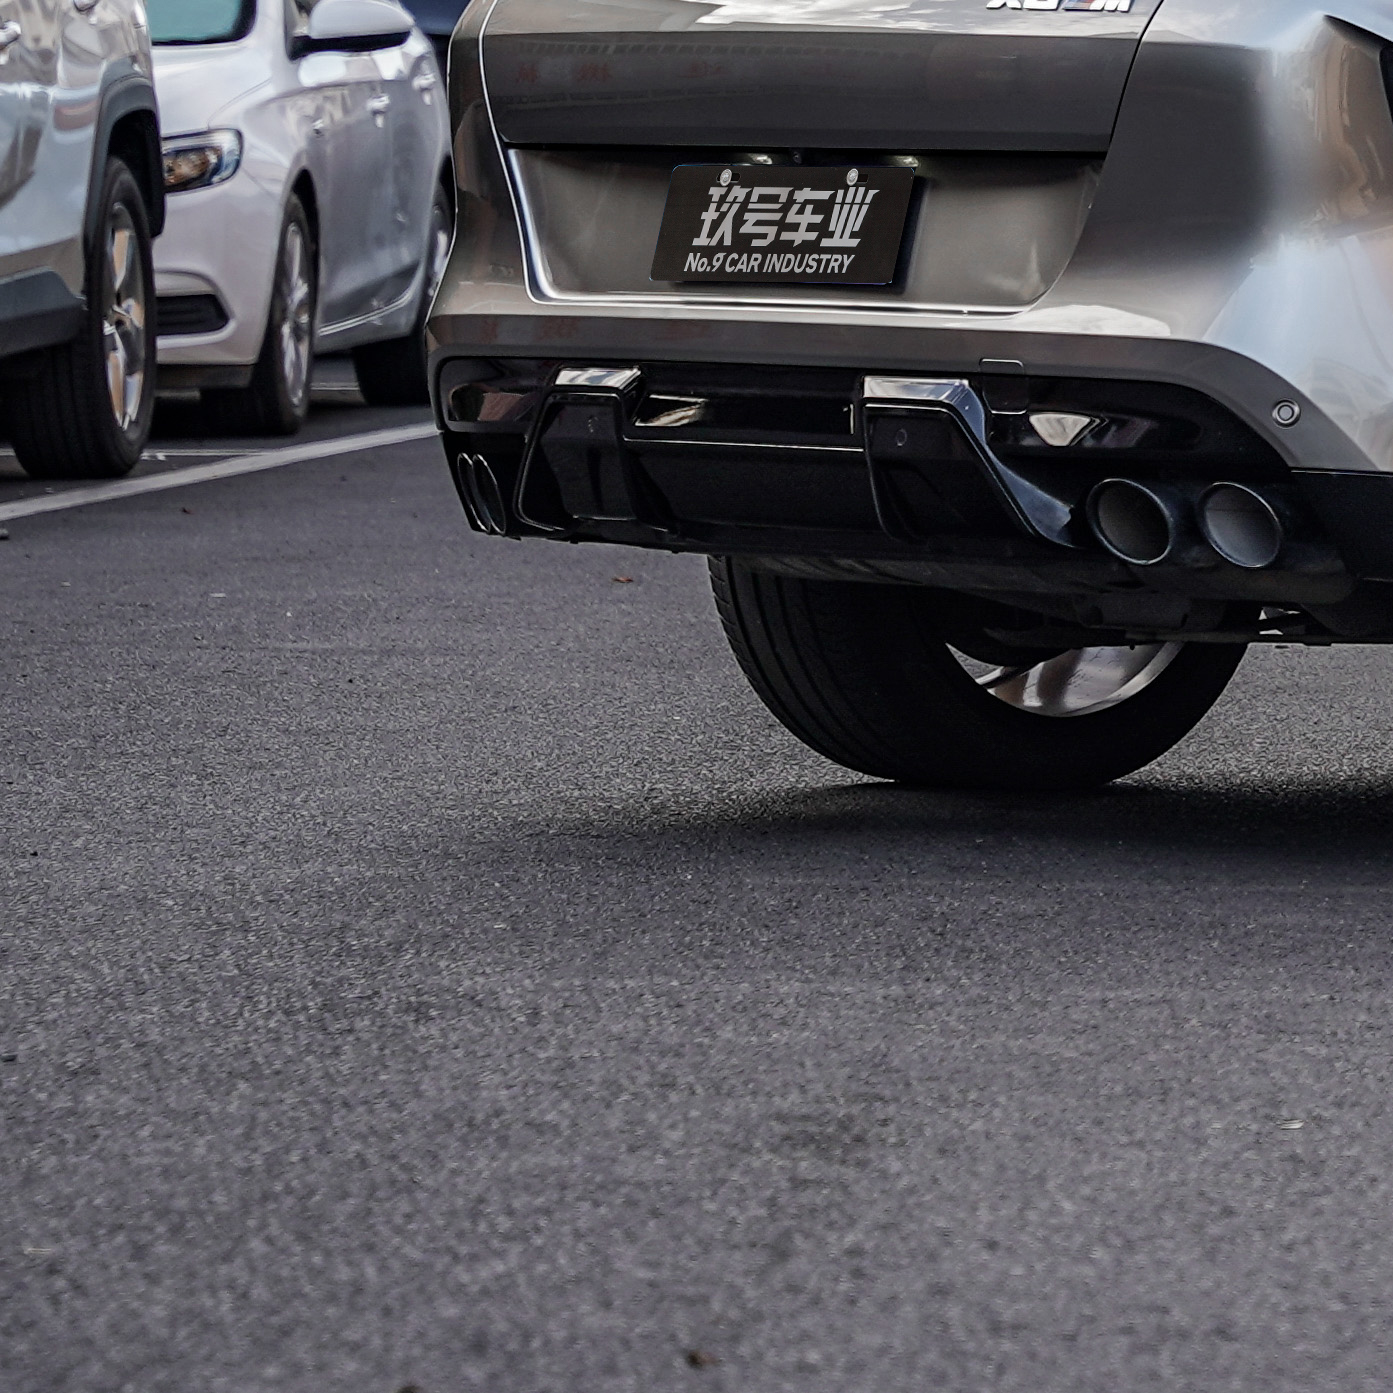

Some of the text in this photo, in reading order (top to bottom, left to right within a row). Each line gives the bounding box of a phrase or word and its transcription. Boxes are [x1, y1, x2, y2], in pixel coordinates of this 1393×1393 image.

[691, 185, 880, 247] 玖号车业
[684, 252, 855, 274] No.9 CAR INDUSTRY
